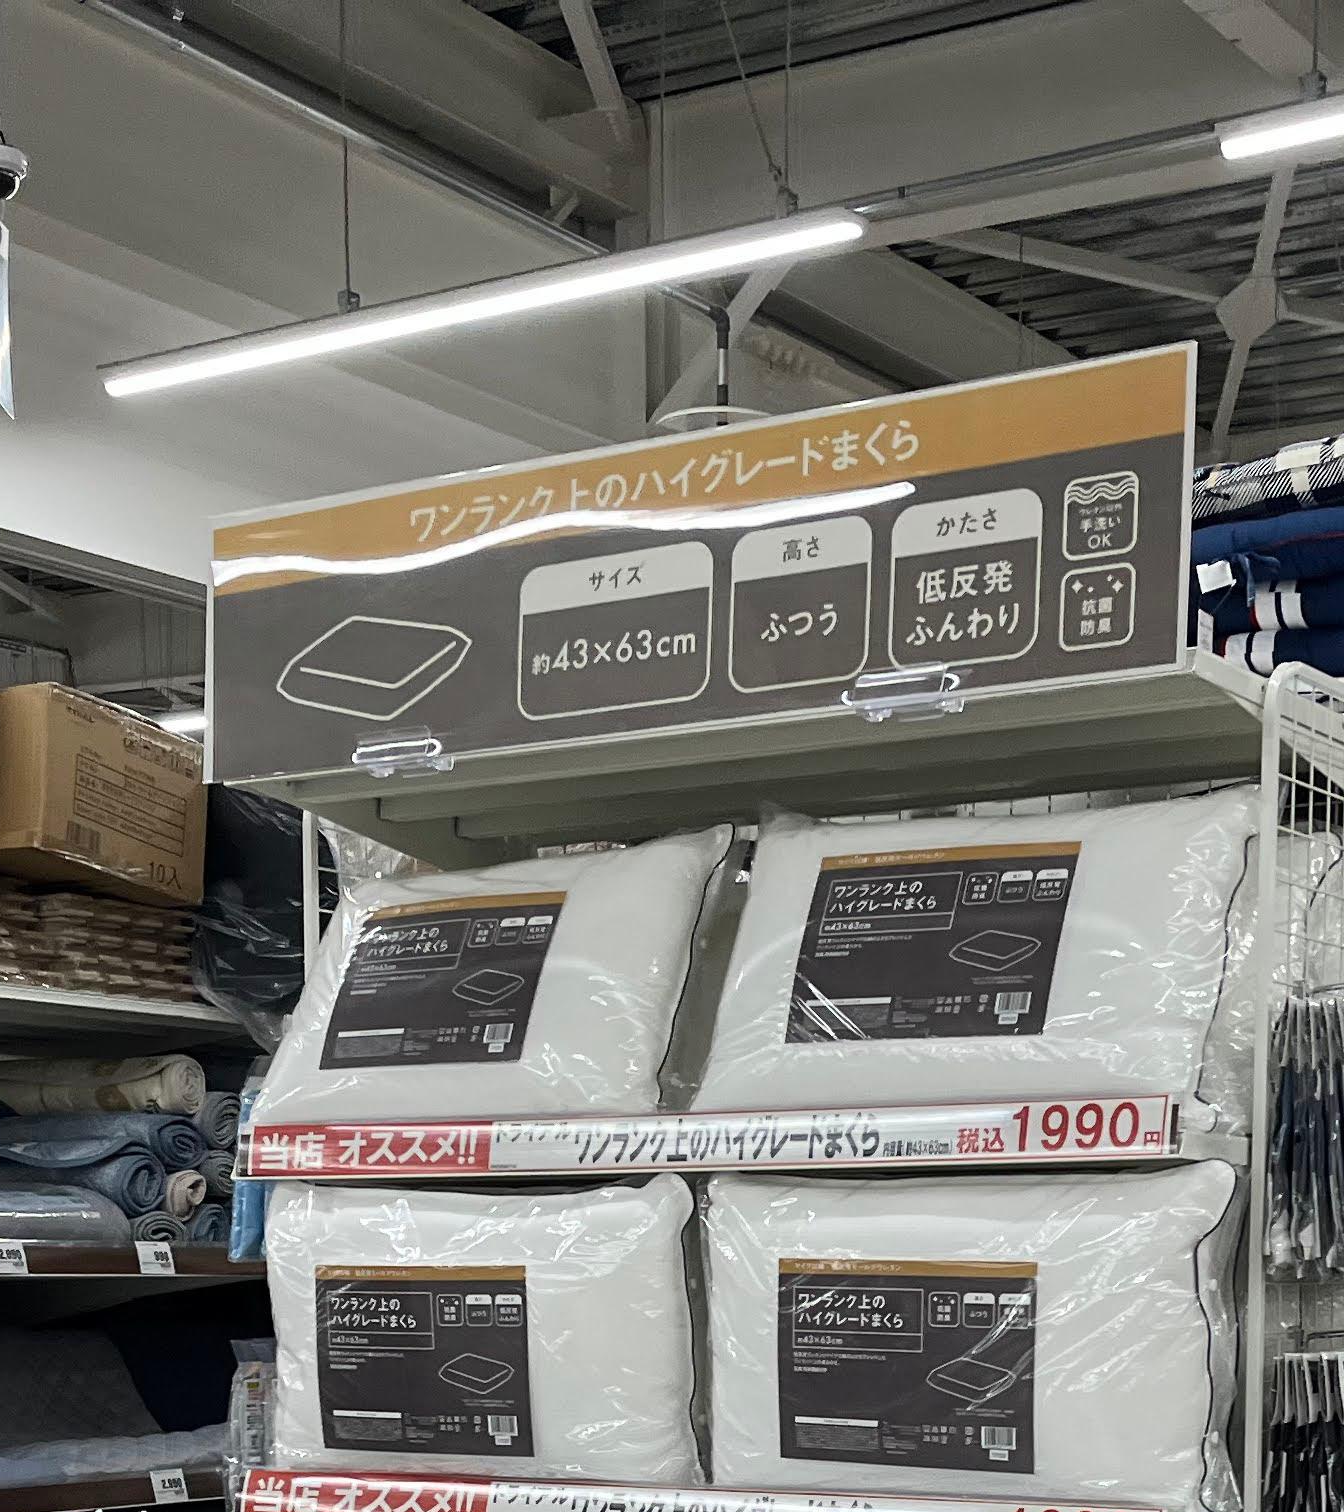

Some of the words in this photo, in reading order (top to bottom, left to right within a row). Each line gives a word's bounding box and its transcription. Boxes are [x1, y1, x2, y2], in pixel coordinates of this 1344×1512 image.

[409, 420, 920, 545] ワンランク上のハイグレードまくら
[936, 506, 1000, 538] かたさ
[1080, 516, 1121, 532] 手洗い
[782, 534, 821, 562] 高さ
[1087, 534, 1112, 549] OK
[587, 563, 644, 592] サイズ
[916, 560, 1015, 605] 低反発
[760, 603, 839, 644] ふつう
[905, 604, 1022, 648] ふんわり
[530, 627, 697, 676] 約43×63cm
[834, 881, 923, 898] ワンランク上の
[829, 896, 937, 914] ハイグレードまくら
[258, 1132, 324, 1169] 当店
[338, 1129, 477, 1167] オススメ!!
[576, 1113, 880, 1164] ワンランク上のハイグレードまくら
[957, 1127, 1005, 1154] 税込
[330, 1296, 401, 1312] ワンランク上の
[797, 1293, 886, 1310] ワンランク上の
[330, 1313, 418, 1328] ハイグレードまくら
[797, 1312, 904, 1329] ハイグレードまくら
